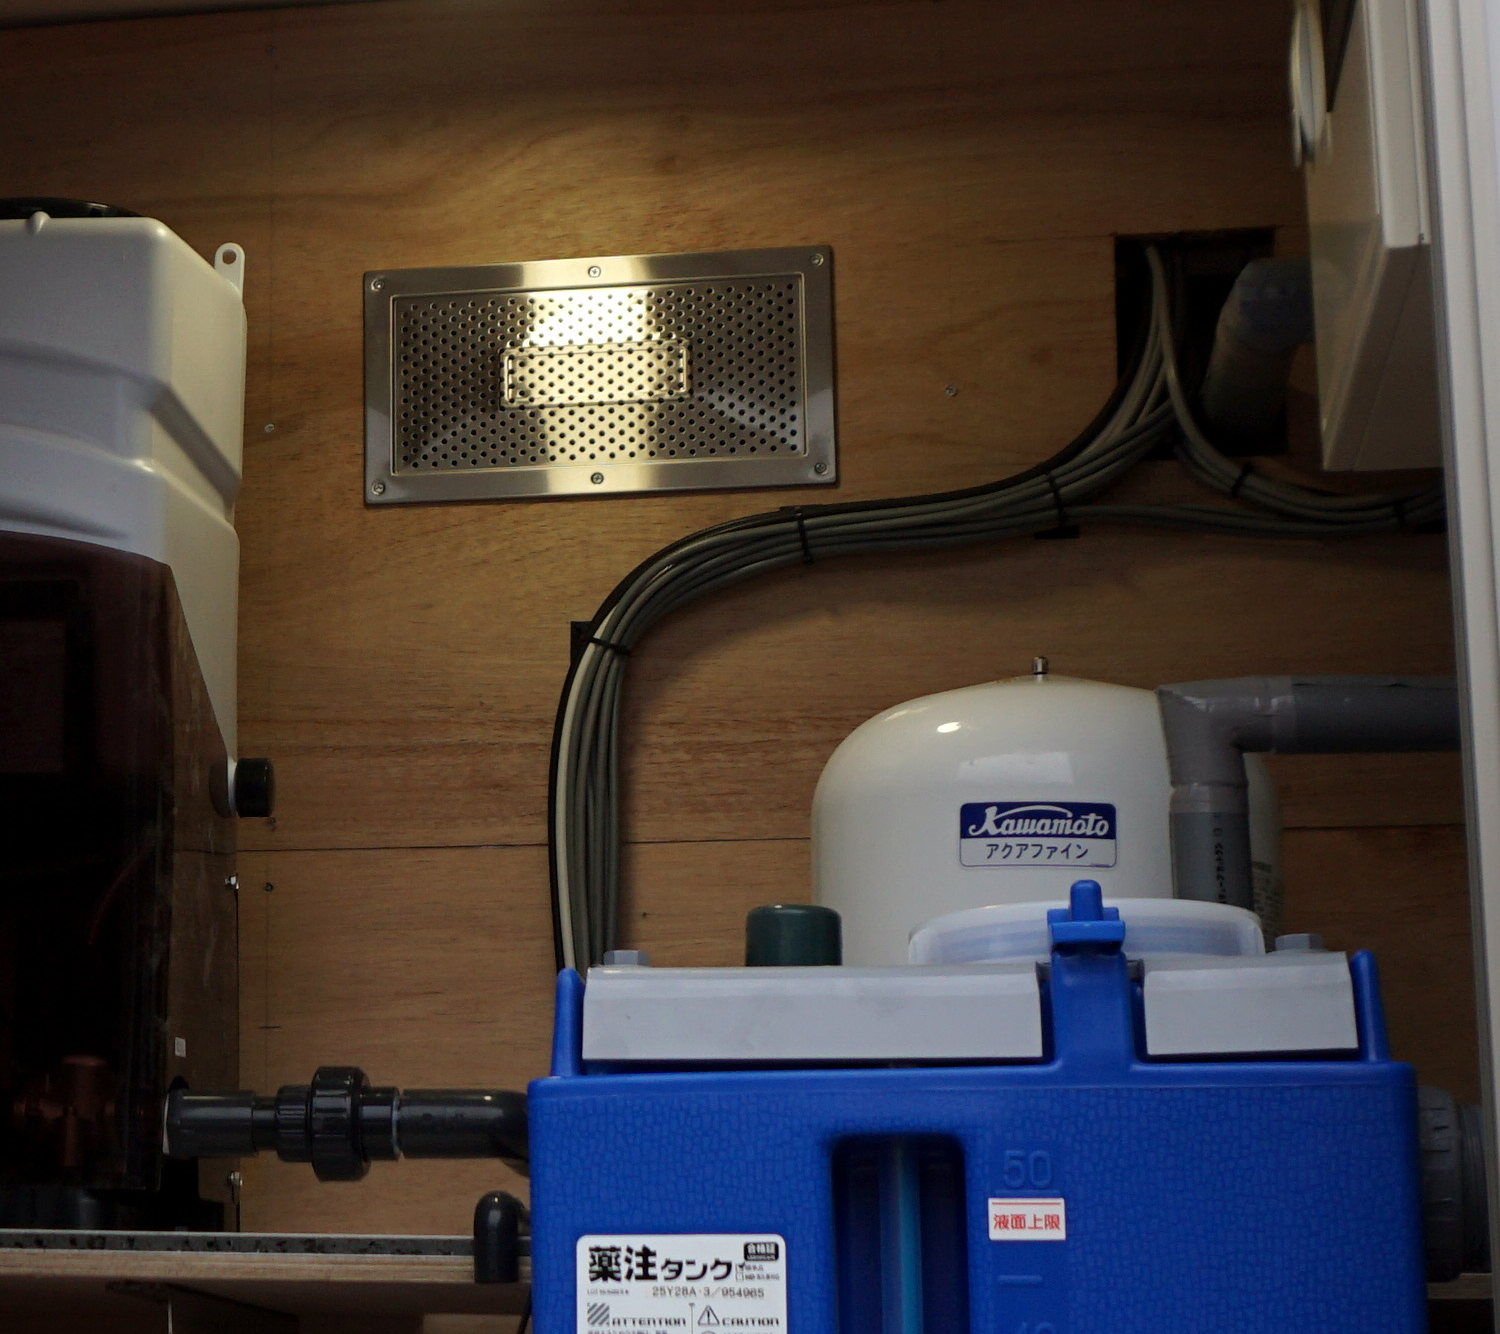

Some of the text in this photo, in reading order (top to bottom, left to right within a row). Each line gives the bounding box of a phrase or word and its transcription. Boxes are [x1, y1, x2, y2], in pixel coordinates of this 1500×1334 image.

[968, 805, 1109, 837] Kawamoto
[986, 842, 1088, 860] アクアファイン
[1003, 1150, 1052, 1189] 50
[994, 1214, 1060, 1230] 液面上限
[588, 1244, 732, 1283] 薬注タンク
[722, 1317, 779, 1326] CAUTION
